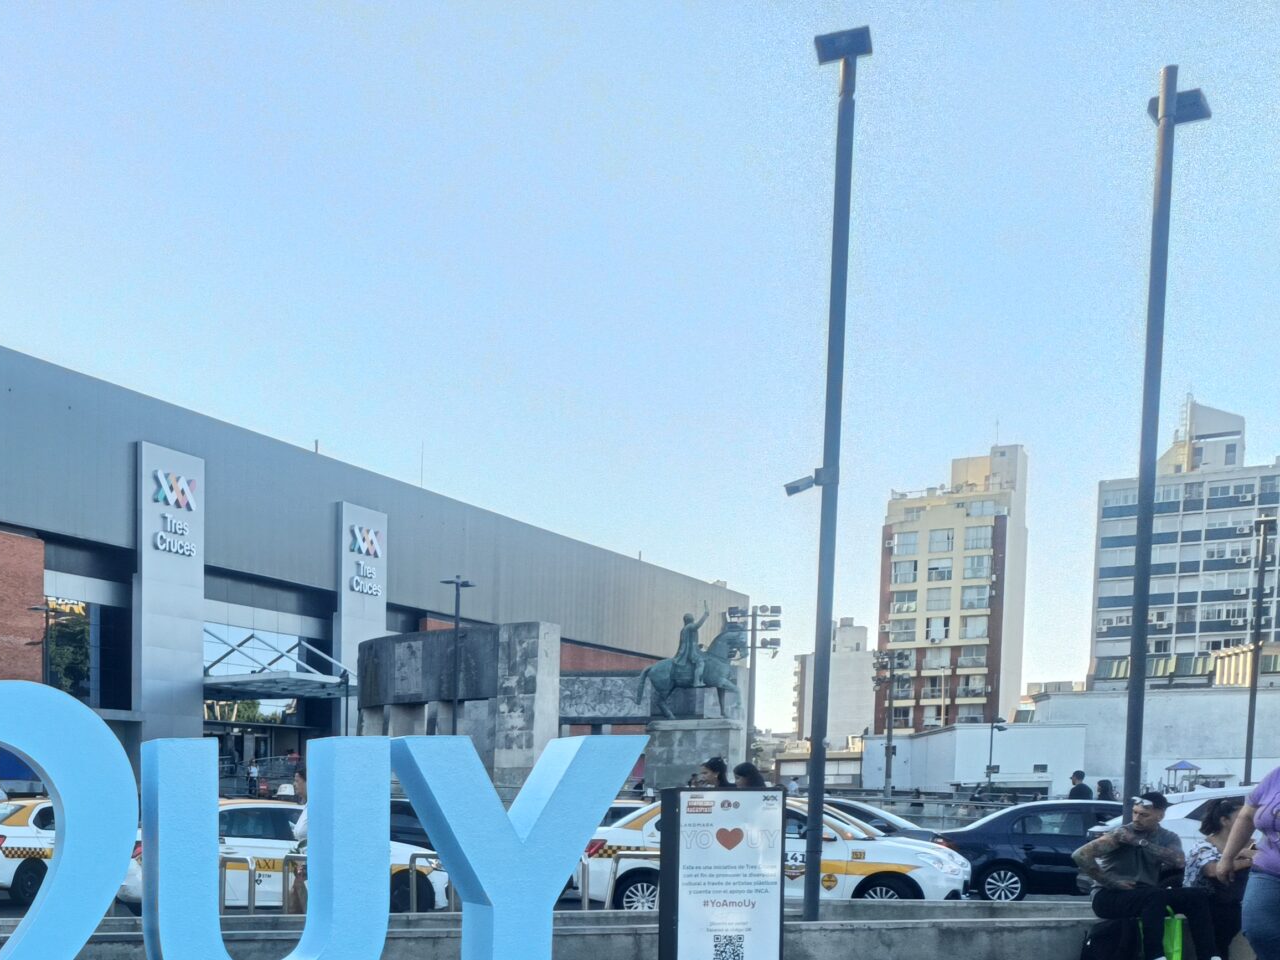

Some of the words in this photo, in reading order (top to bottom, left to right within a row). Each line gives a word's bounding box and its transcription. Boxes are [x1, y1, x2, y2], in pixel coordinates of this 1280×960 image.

[162, 513, 189, 535] Tres
[155, 531, 196, 556] Cruces
[357, 560, 376, 578] Tres
[352, 576, 381, 596] Cruces
[255, 858, 276, 870] AXI
[703, 899, 757, 909] #YoAmoUy
